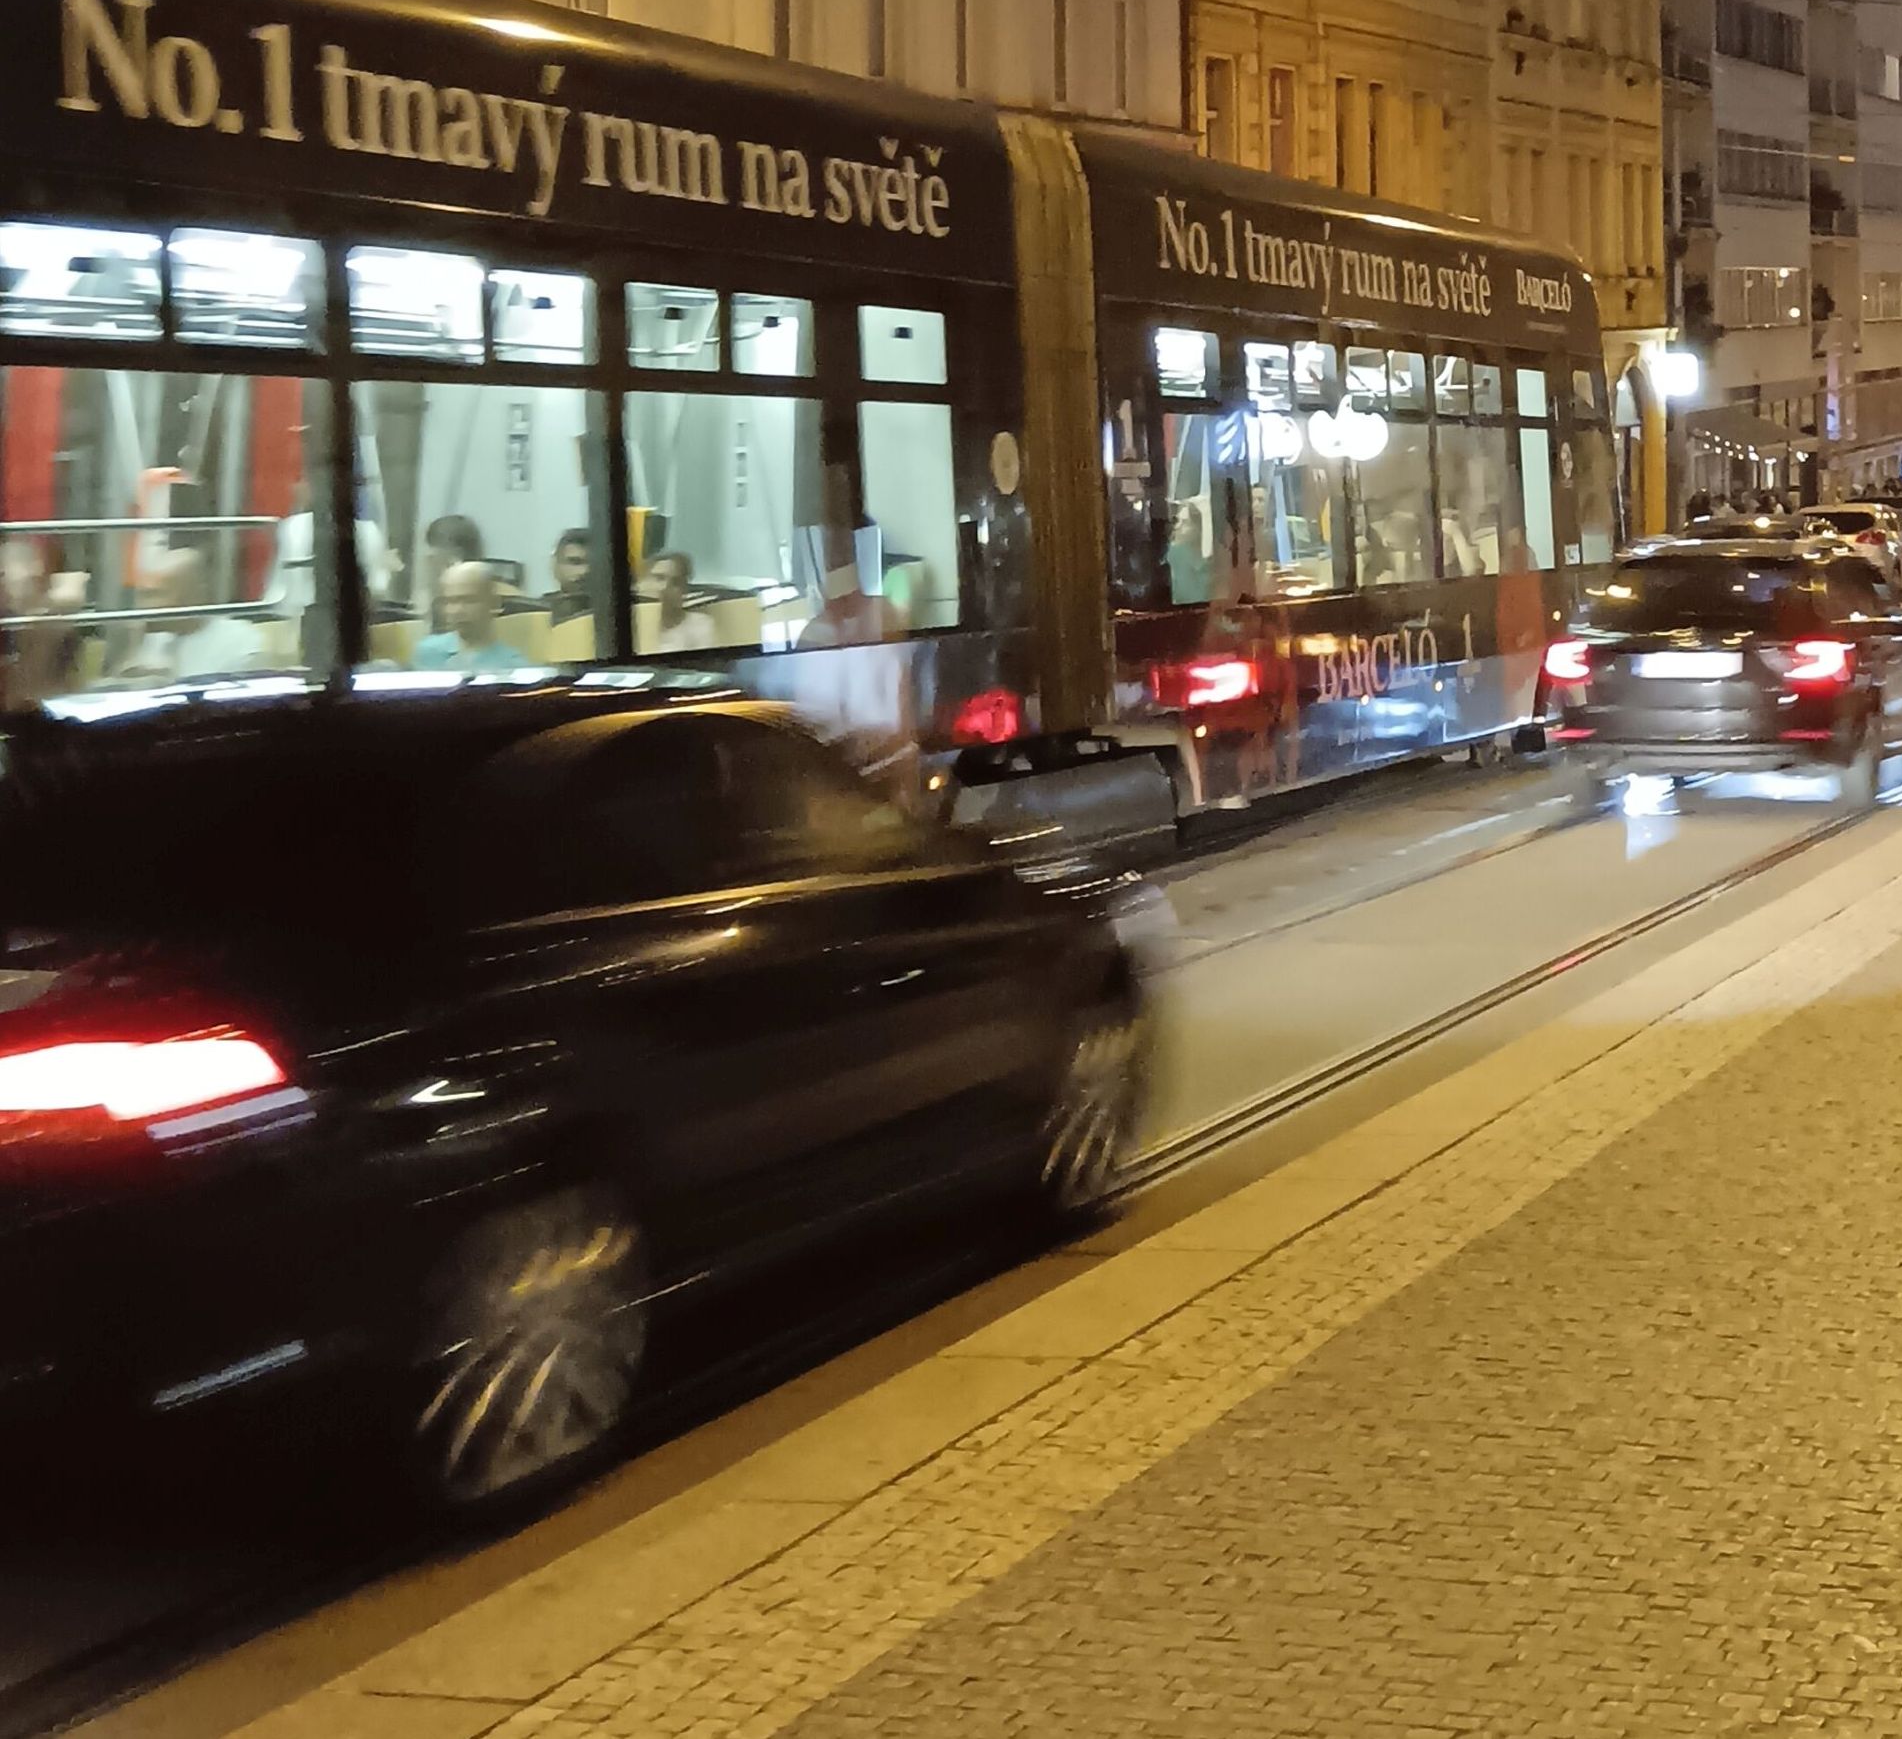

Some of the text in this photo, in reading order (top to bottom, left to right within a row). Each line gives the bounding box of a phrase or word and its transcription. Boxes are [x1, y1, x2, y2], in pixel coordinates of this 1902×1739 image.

[320, 43, 568, 216] tmavý
[582, 112, 729, 205] rum
[739, 138, 815, 218] na
[824, 136, 951, 239] světě
[1245, 220, 1335, 314] tmavý
[1340, 248, 1397, 302] rum
[1403, 258, 1434, 309] na
[1437, 251, 1491, 317] světě
